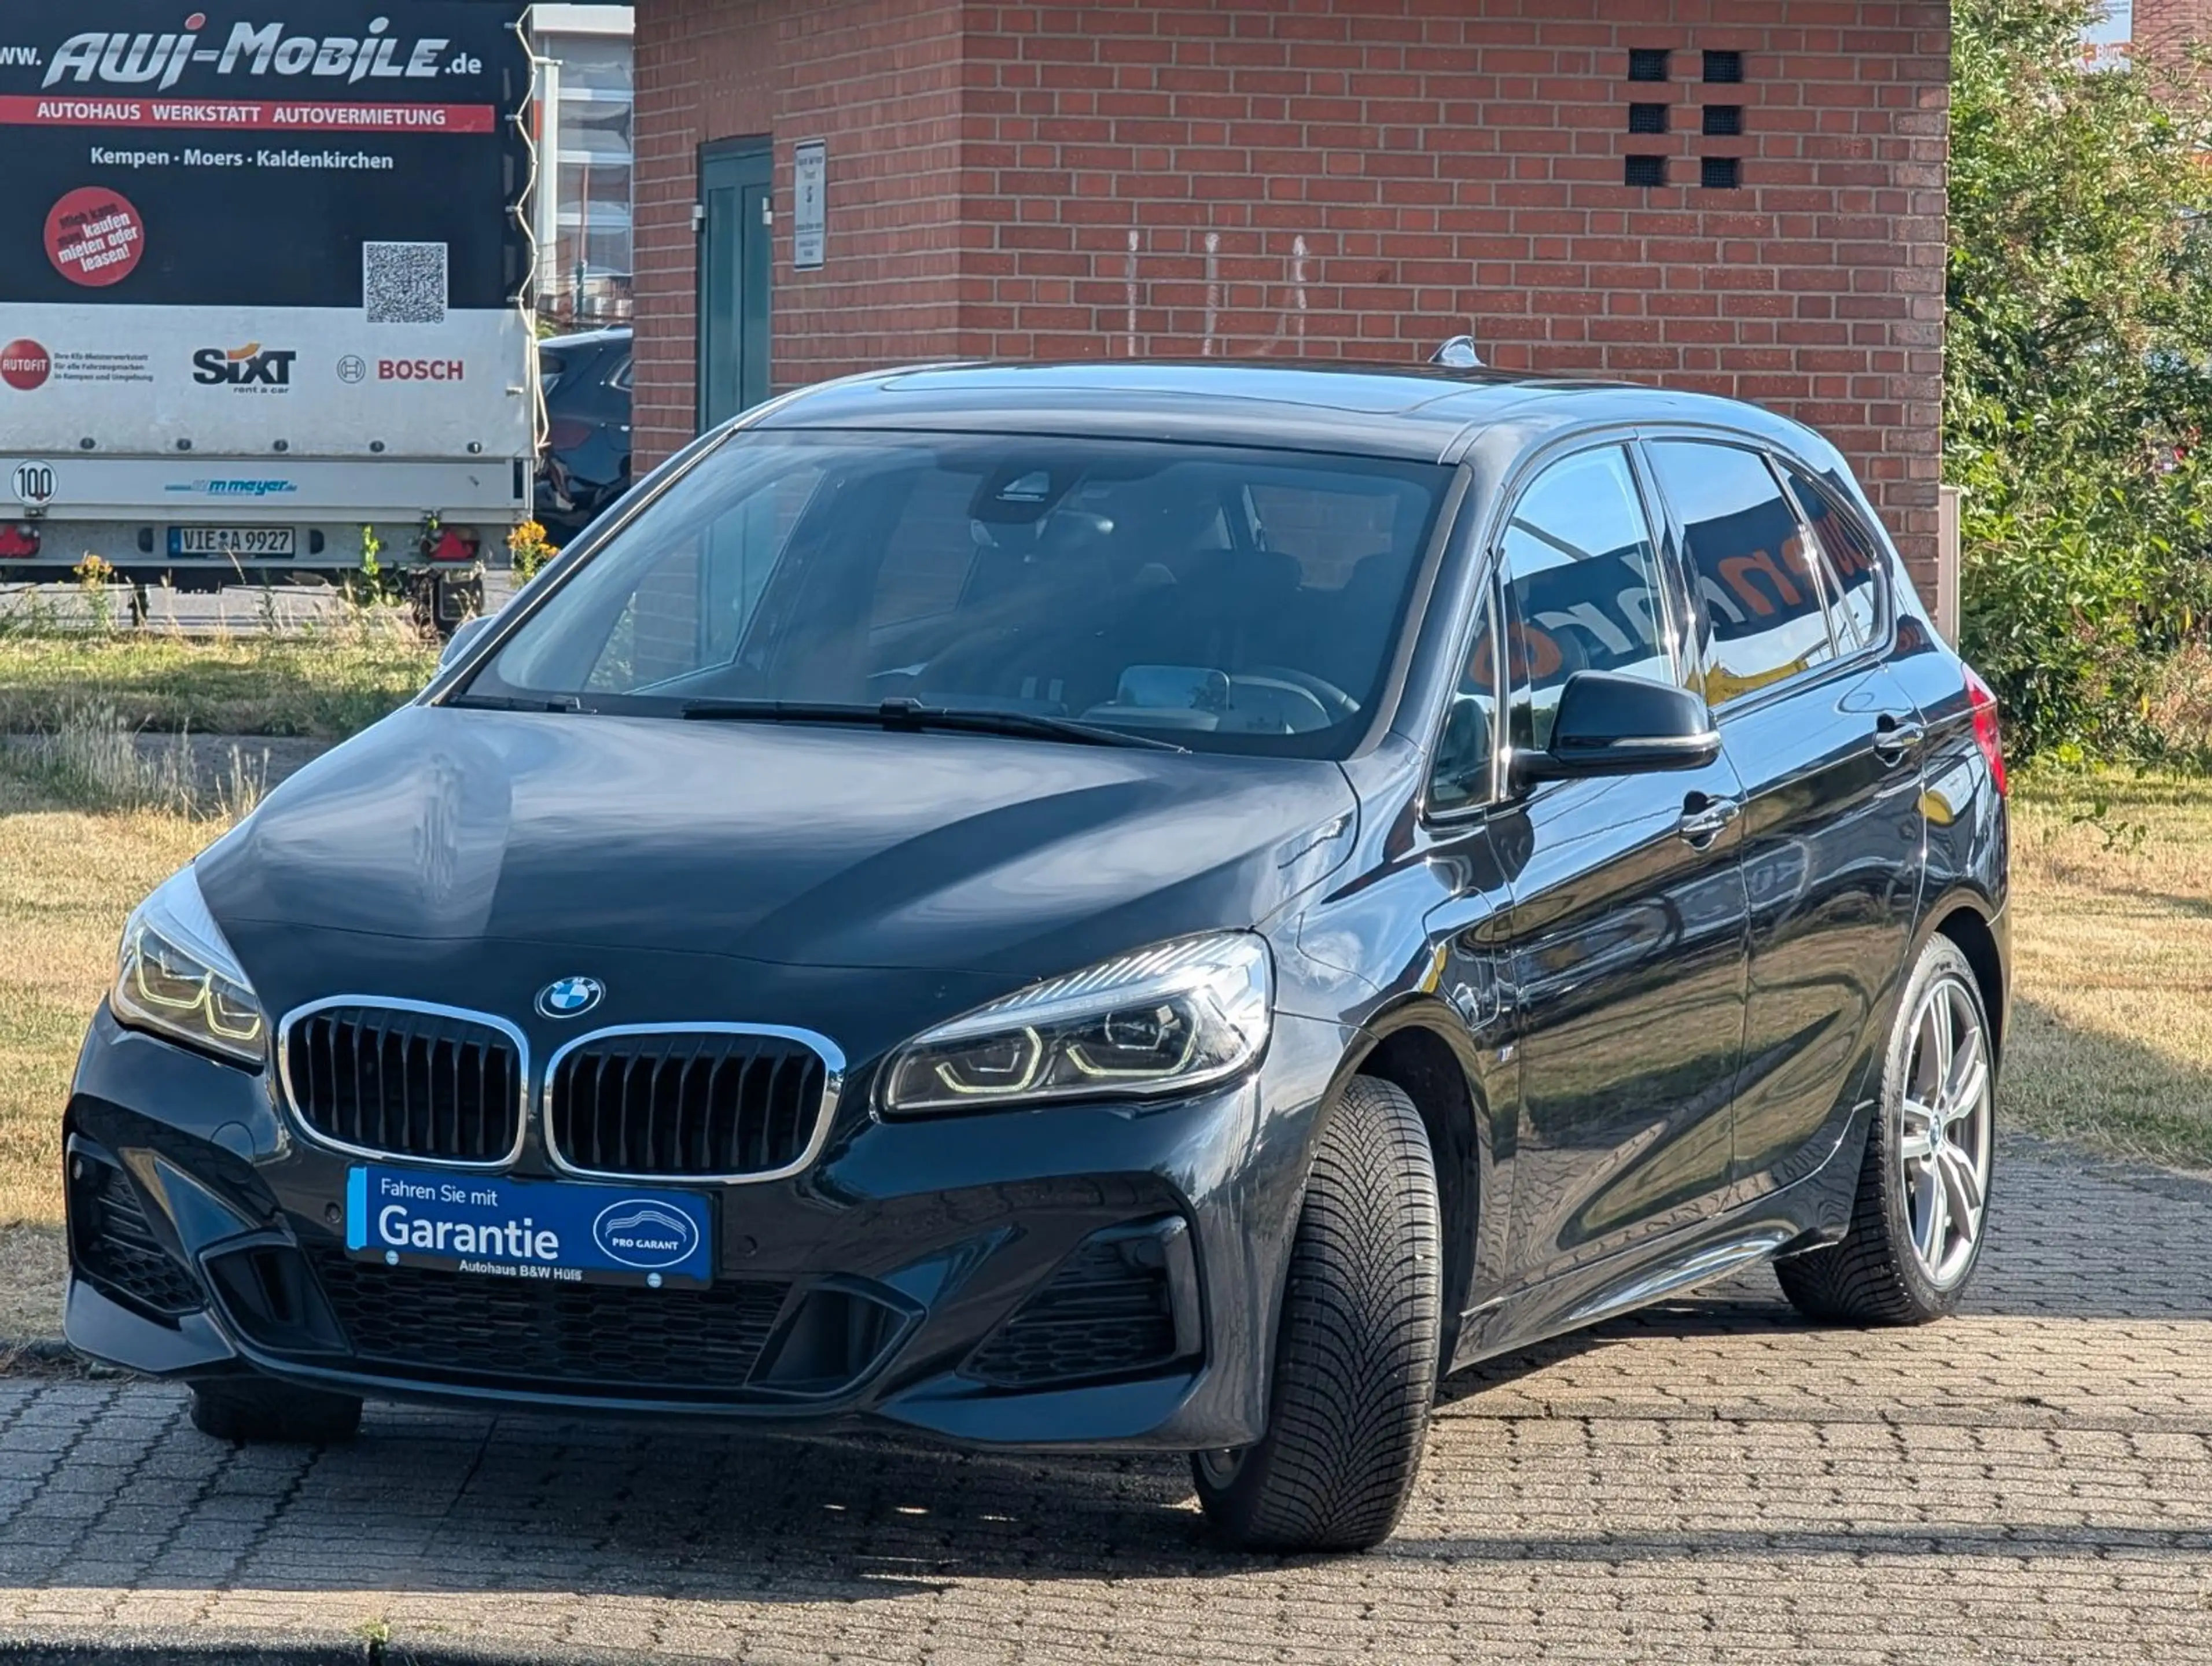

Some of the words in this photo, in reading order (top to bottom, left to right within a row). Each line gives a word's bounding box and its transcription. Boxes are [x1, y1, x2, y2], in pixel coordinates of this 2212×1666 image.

[37, 102, 141, 120] AUTOHAUS
[152, 104, 261, 122] WERKSTATT
[273, 108, 446, 126] AUTOVERMIETUNG
[90, 147, 170, 168] Kempen
[183, 149, 242, 166] Moers
[257, 150, 393, 169] Kaldenkirchen
[82, 213, 130, 238] kaufen
[58, 238, 105, 263] mieten
[108, 227, 138, 246] oder
[80, 244, 130, 272] leasen!
[2, 359, 48, 372] AUTOFIT
[378, 360, 463, 379] BOSCH
[18, 467, 52, 497] 100
[183, 530, 216, 550] VIE
[245, 531, 289, 551] 9927
[381, 1178, 435, 1200] Fahren
[440, 1184, 466, 1203] Sie
[470, 1189, 498, 1207] mit
[379, 1204, 559, 1260] Garantie
[612, 1237, 634, 1248] PRO
[636, 1240, 679, 1251] GARANT
[459, 1259, 516, 1276] Autohaus
[520, 1265, 551, 1278] B&W
